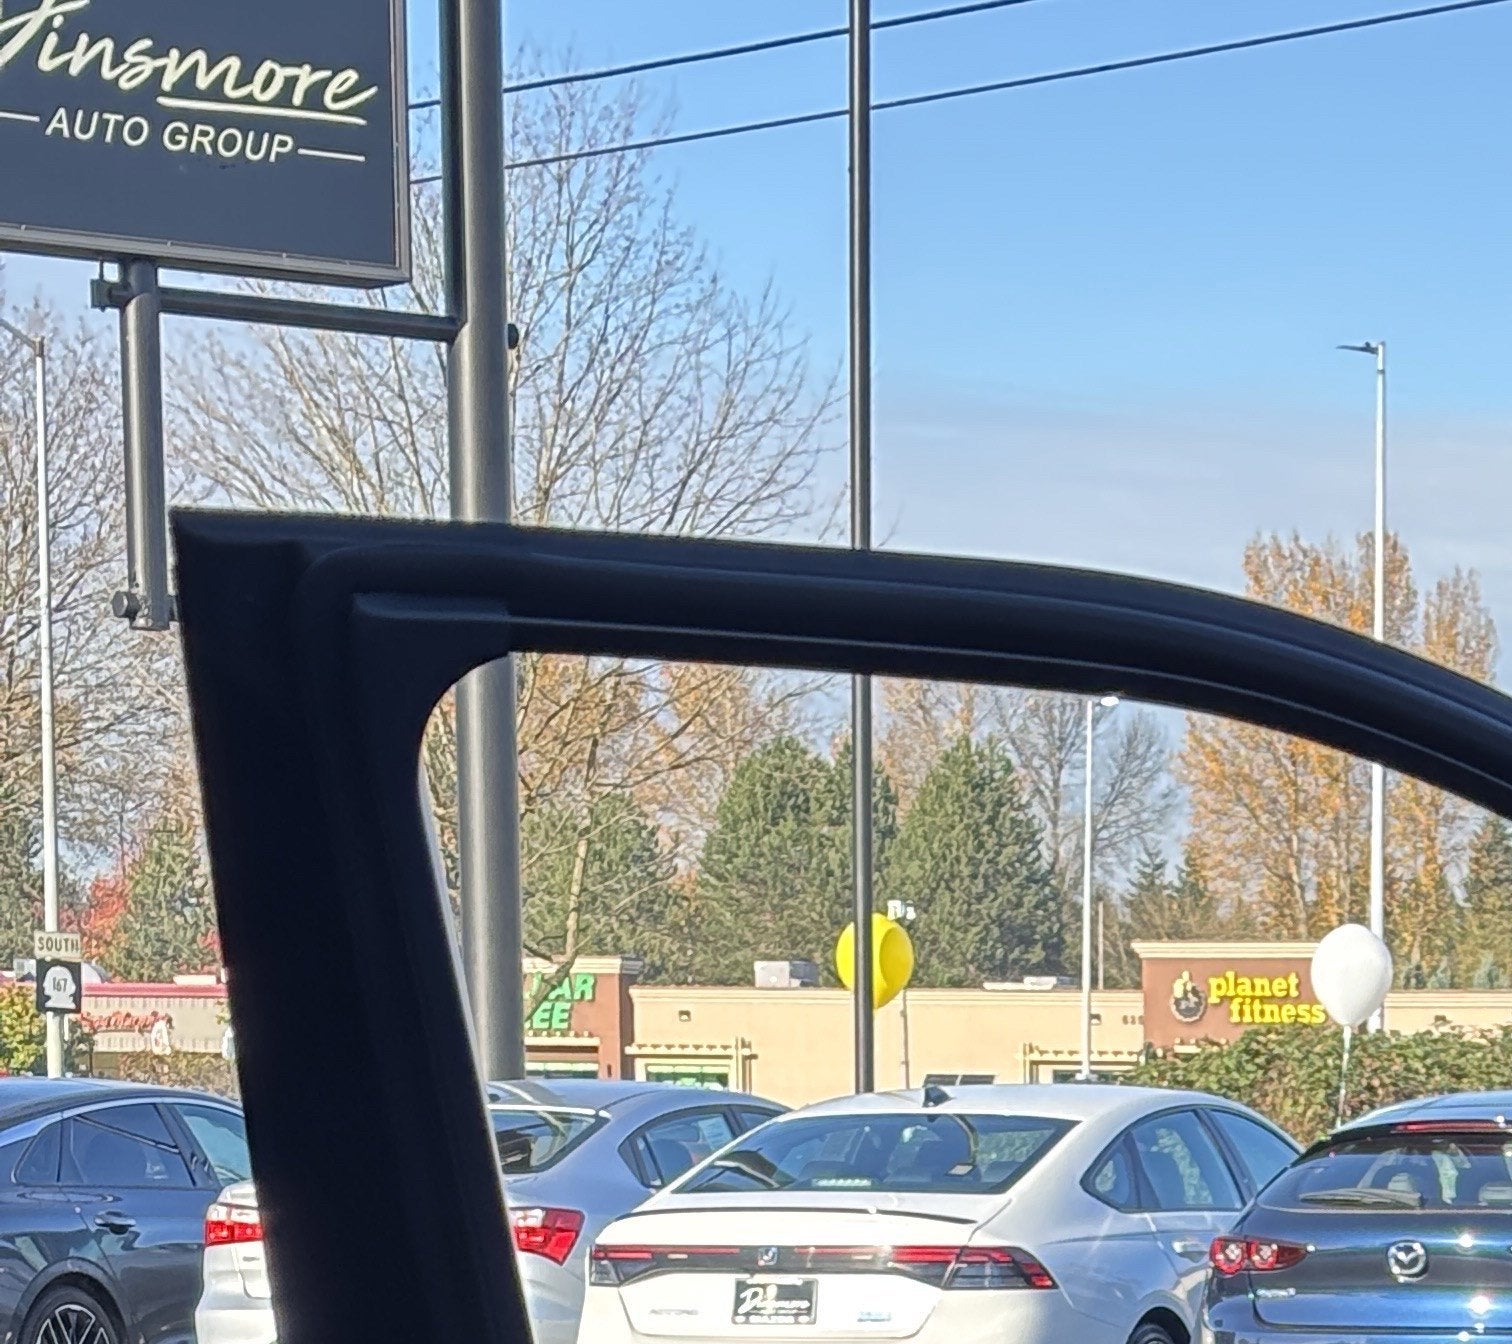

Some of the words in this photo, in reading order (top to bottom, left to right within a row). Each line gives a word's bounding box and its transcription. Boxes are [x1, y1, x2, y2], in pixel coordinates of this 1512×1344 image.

[45, 106, 149, 147] AUTO
[162, 121, 294, 163] GROUP
[37, 936, 79, 951] SOUTH
[52, 976, 68, 993] 167
[1208, 970, 1299, 1004] planet
[524, 1001, 572, 1029] EE
[1229, 998, 1327, 1024] fitness
